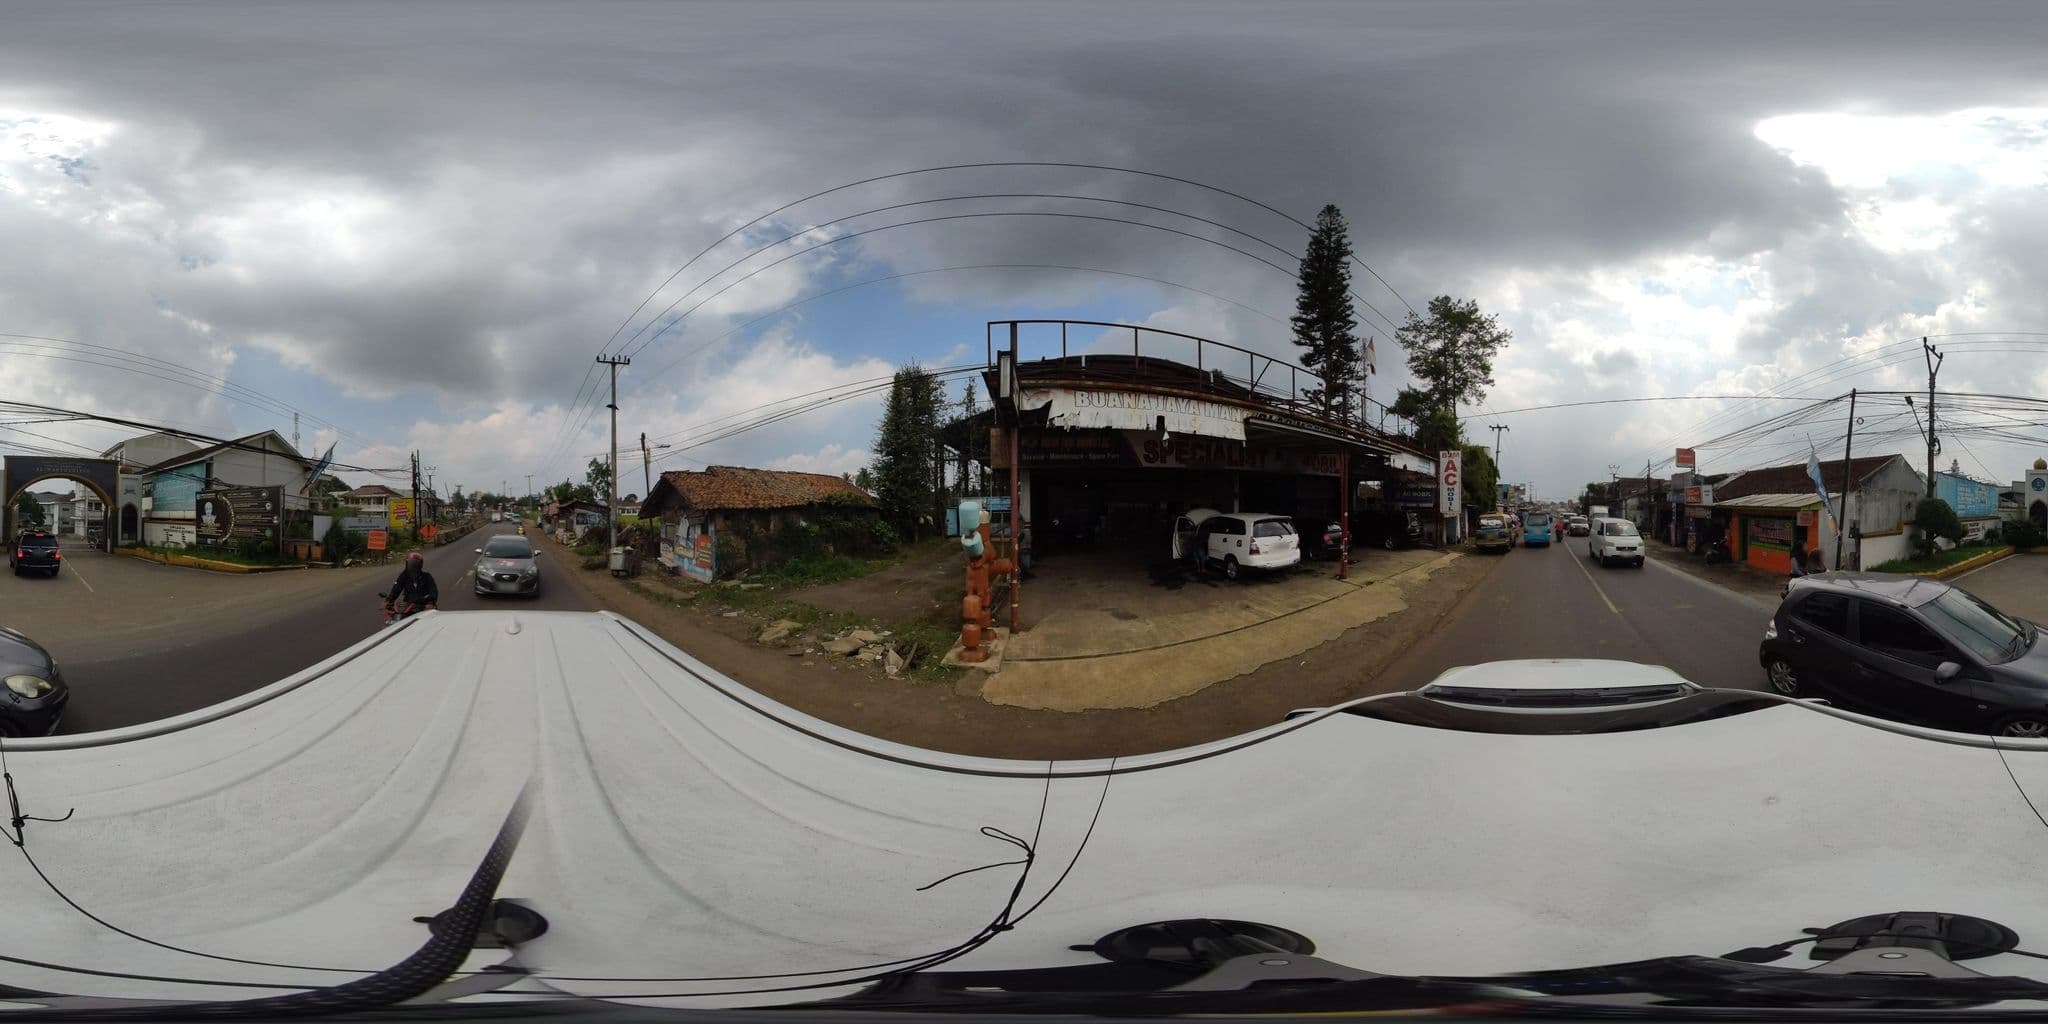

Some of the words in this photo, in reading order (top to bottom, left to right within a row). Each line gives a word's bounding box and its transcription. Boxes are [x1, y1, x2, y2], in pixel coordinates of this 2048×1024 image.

[1074, 391, 1151, 410] BUANA
[1151, 395, 1200, 415] JAYA
[1444, 459, 1457, 486] AC
